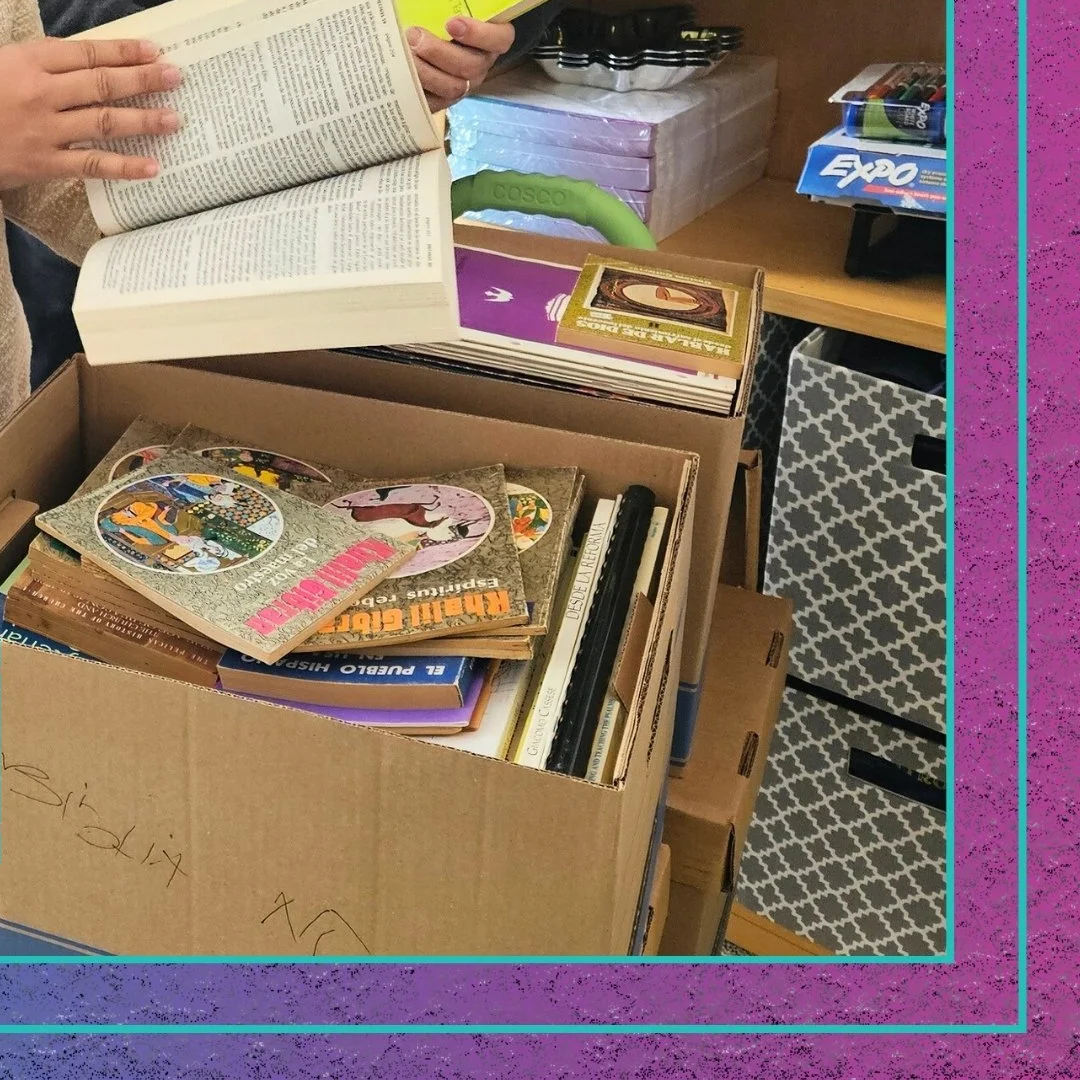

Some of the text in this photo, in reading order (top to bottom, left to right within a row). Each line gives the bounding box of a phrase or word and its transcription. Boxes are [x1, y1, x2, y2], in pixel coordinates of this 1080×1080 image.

[916, 102, 930, 130] EXPO
[820, 154, 919, 189] EXPO
[493, 183, 568, 206] COSCO
[575, 318, 620, 333] DIOS
[622, 326, 648, 339] DE
[649, 332, 731, 356] HABLAR
[234, 538, 317, 592] del maestro
[266, 555, 315, 586] La voz
[406, 577, 499, 602] Espíritus
[409, 591, 510, 625] Khalil
[69, 604, 209, 666] THE PELICAN HISTORY THE
[525, 519, 607, 757] GIACOMO CASSESE DESDE LA REFORMA
[340, 665, 445, 675] EL PUEBLO
[601, 718, 612, 732] THE
[593, 730, 608, 759] TEACHING
[590, 757, 601, 771] AND
